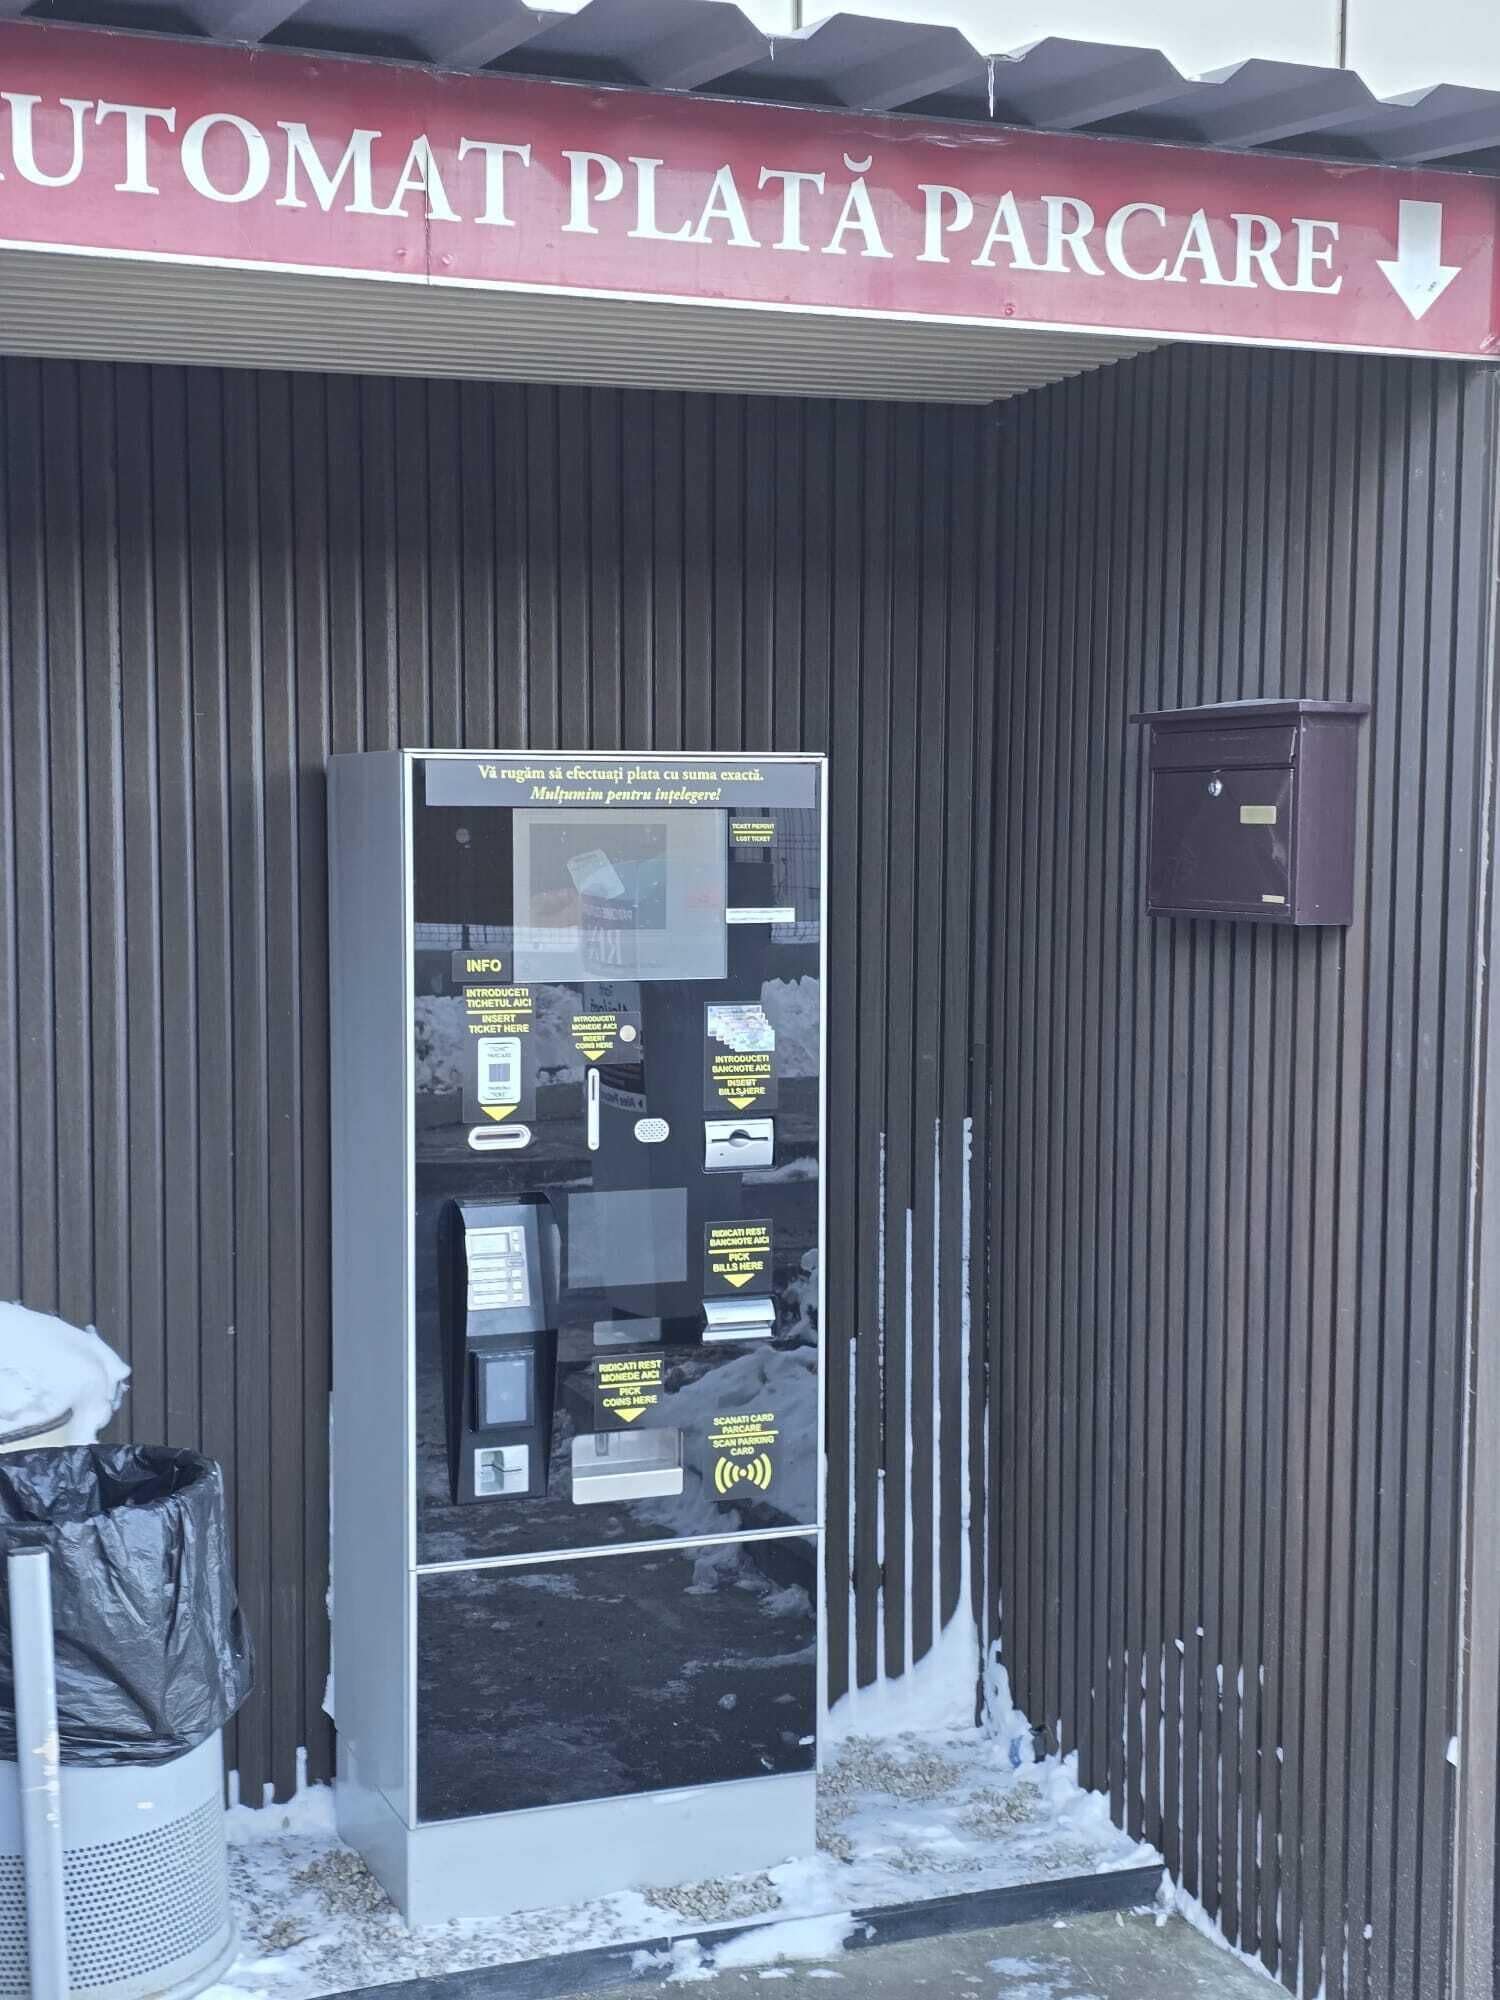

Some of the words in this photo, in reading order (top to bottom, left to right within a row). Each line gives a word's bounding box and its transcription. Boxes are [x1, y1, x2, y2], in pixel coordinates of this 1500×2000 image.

[0, 91, 531, 227] UTOMAT
[561, 150, 894, 258] PLATĂ
[916, 184, 1342, 294] PARCARE
[478, 764, 497, 779] Vă
[501, 766, 545, 783] rugăm
[548, 766, 563, 779] să
[626, 766, 660, 784] plata
[663, 769, 679, 780] cu
[681, 770, 717, 780] suma
[720, 768, 764, 781] exactă.
[604, 790, 652, 804] pentru
[466, 959, 502, 973] INFO
[466, 988, 529, 998] INTRODUCETI
[466, 998, 512, 1008] TICHETUL
[513, 998, 532, 1007] AICI
[482, 1014, 516, 1023] INSERT
[573, 1015, 616, 1023] INTRODUCETI
[468, 1024, 502, 1034] TICKET
[503, 1023, 530, 1033] HERE
[571, 1023, 602, 1031] MONEDE
[602, 1023, 618, 1031] AICI
[575, 1042, 595, 1050] COINS
[595, 1041, 614, 1049] HERE
[715, 1054, 770, 1063] INTRODUCETI
[711, 1065, 755, 1073] BANCNOTE
[755, 1064, 771, 1072] AICI
[727, 1079, 757, 1087] INSERT
[718, 1087, 740, 1096] BILLS
[743, 1087, 767, 1095] HERE
[711, 1229, 745, 1238] RIDICATI
[745, 1227, 767, 1236] REST
[709, 1237, 753, 1247] BANCNOTE
[753, 1236, 770, 1244] AICI
[728, 1253, 750, 1261] PICK
[712, 1263, 738, 1273] BILLS
[739, 1261, 764, 1271] HERE
[598, 1361, 637, 1373] RIDICATI
[638, 1359, 662, 1370] REST
[601, 1371, 640, 1382] MONEDE
[641, 1370, 660, 1379] AICI
[619, 1387, 641, 1396] PICK
[602, 1397, 632, 1407] COINS
[632, 1394, 658, 1405] HERE
[713, 1415, 750, 1426] SCANATI
[750, 1413, 775, 1423] CARD
[722, 1423, 762, 1434] PARCARE
[712, 1438, 737, 1448] SCAN
[737, 1435, 775, 1446] PARKING
[730, 1446, 755, 1456] CARD
